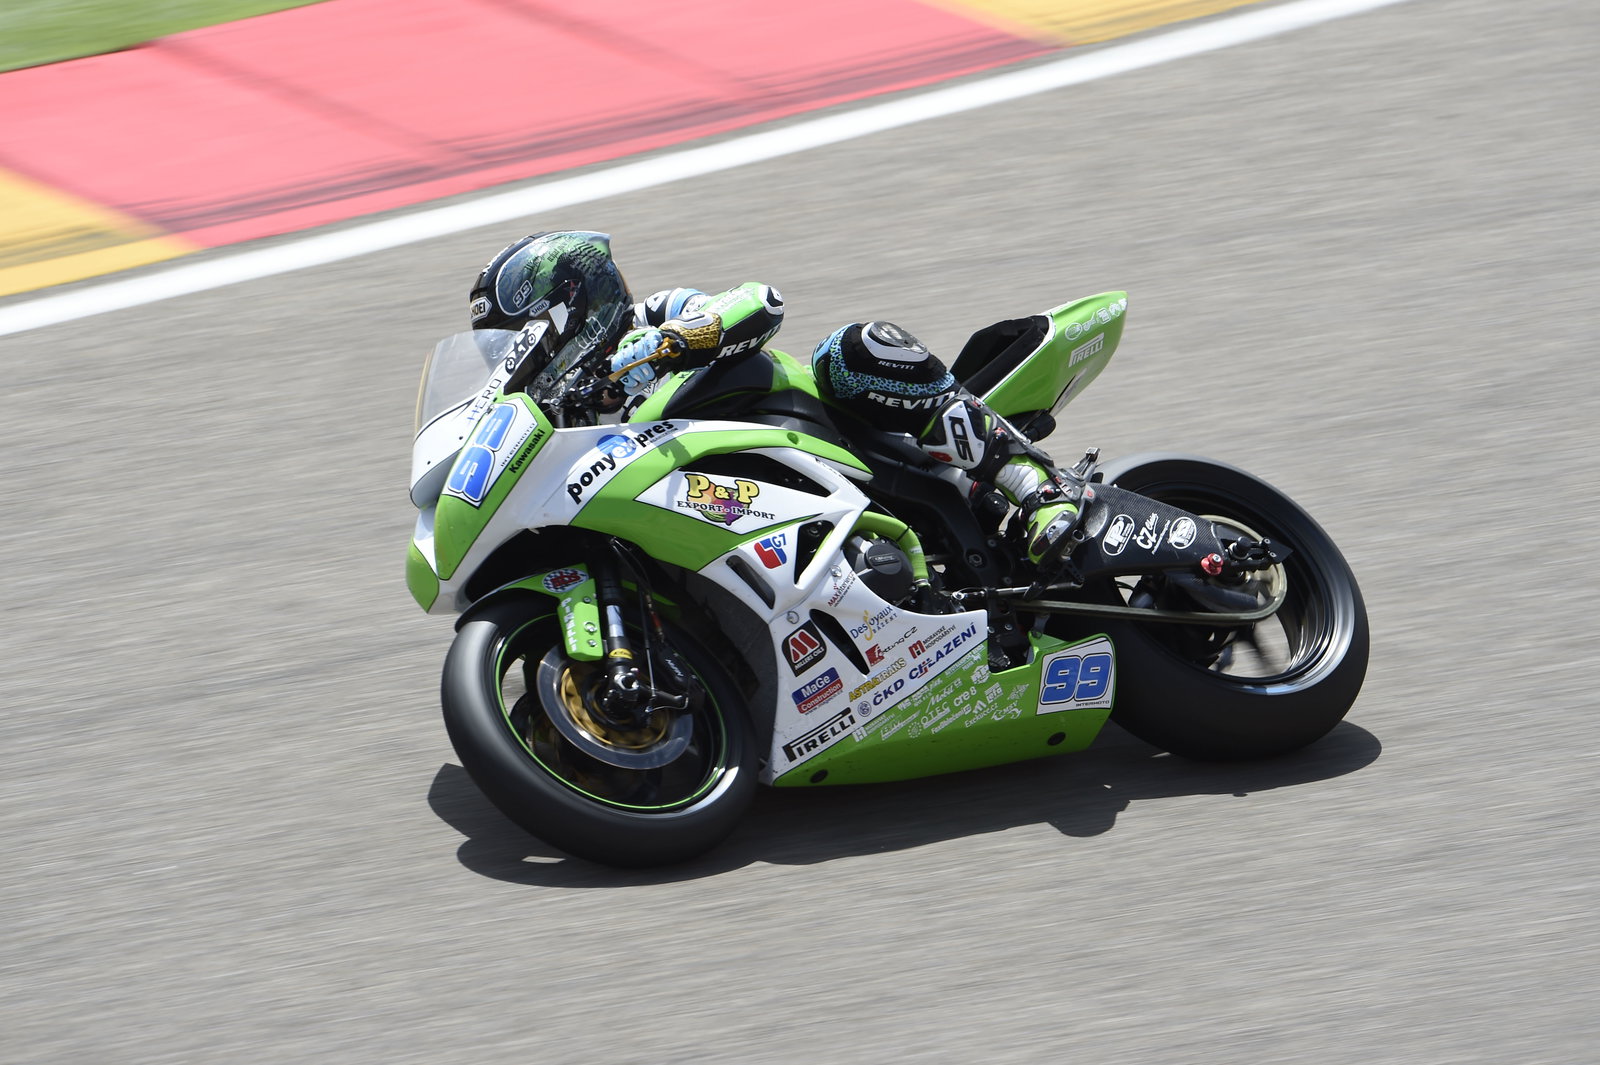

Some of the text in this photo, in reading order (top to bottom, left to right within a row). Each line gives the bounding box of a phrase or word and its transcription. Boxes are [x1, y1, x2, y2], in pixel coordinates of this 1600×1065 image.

[1068, 332, 1105, 368] PIRELLI
[448, 403, 517, 501] 99
[508, 428, 545, 473] Kawasaki
[685, 473, 760, 504] P & P
[677, 500, 723, 512] EXPORT
[732, 507, 776, 520] IMPORT
[771, 533, 786, 548] G7
[850, 605, 893, 640] Desjoyaux
[802, 673, 831, 699] MaGe
[872, 678, 905, 706] ČKD
[1040, 652, 1113, 705] 99
[801, 682, 842, 712] Construction
[781, 706, 856, 763] PIRELLI
